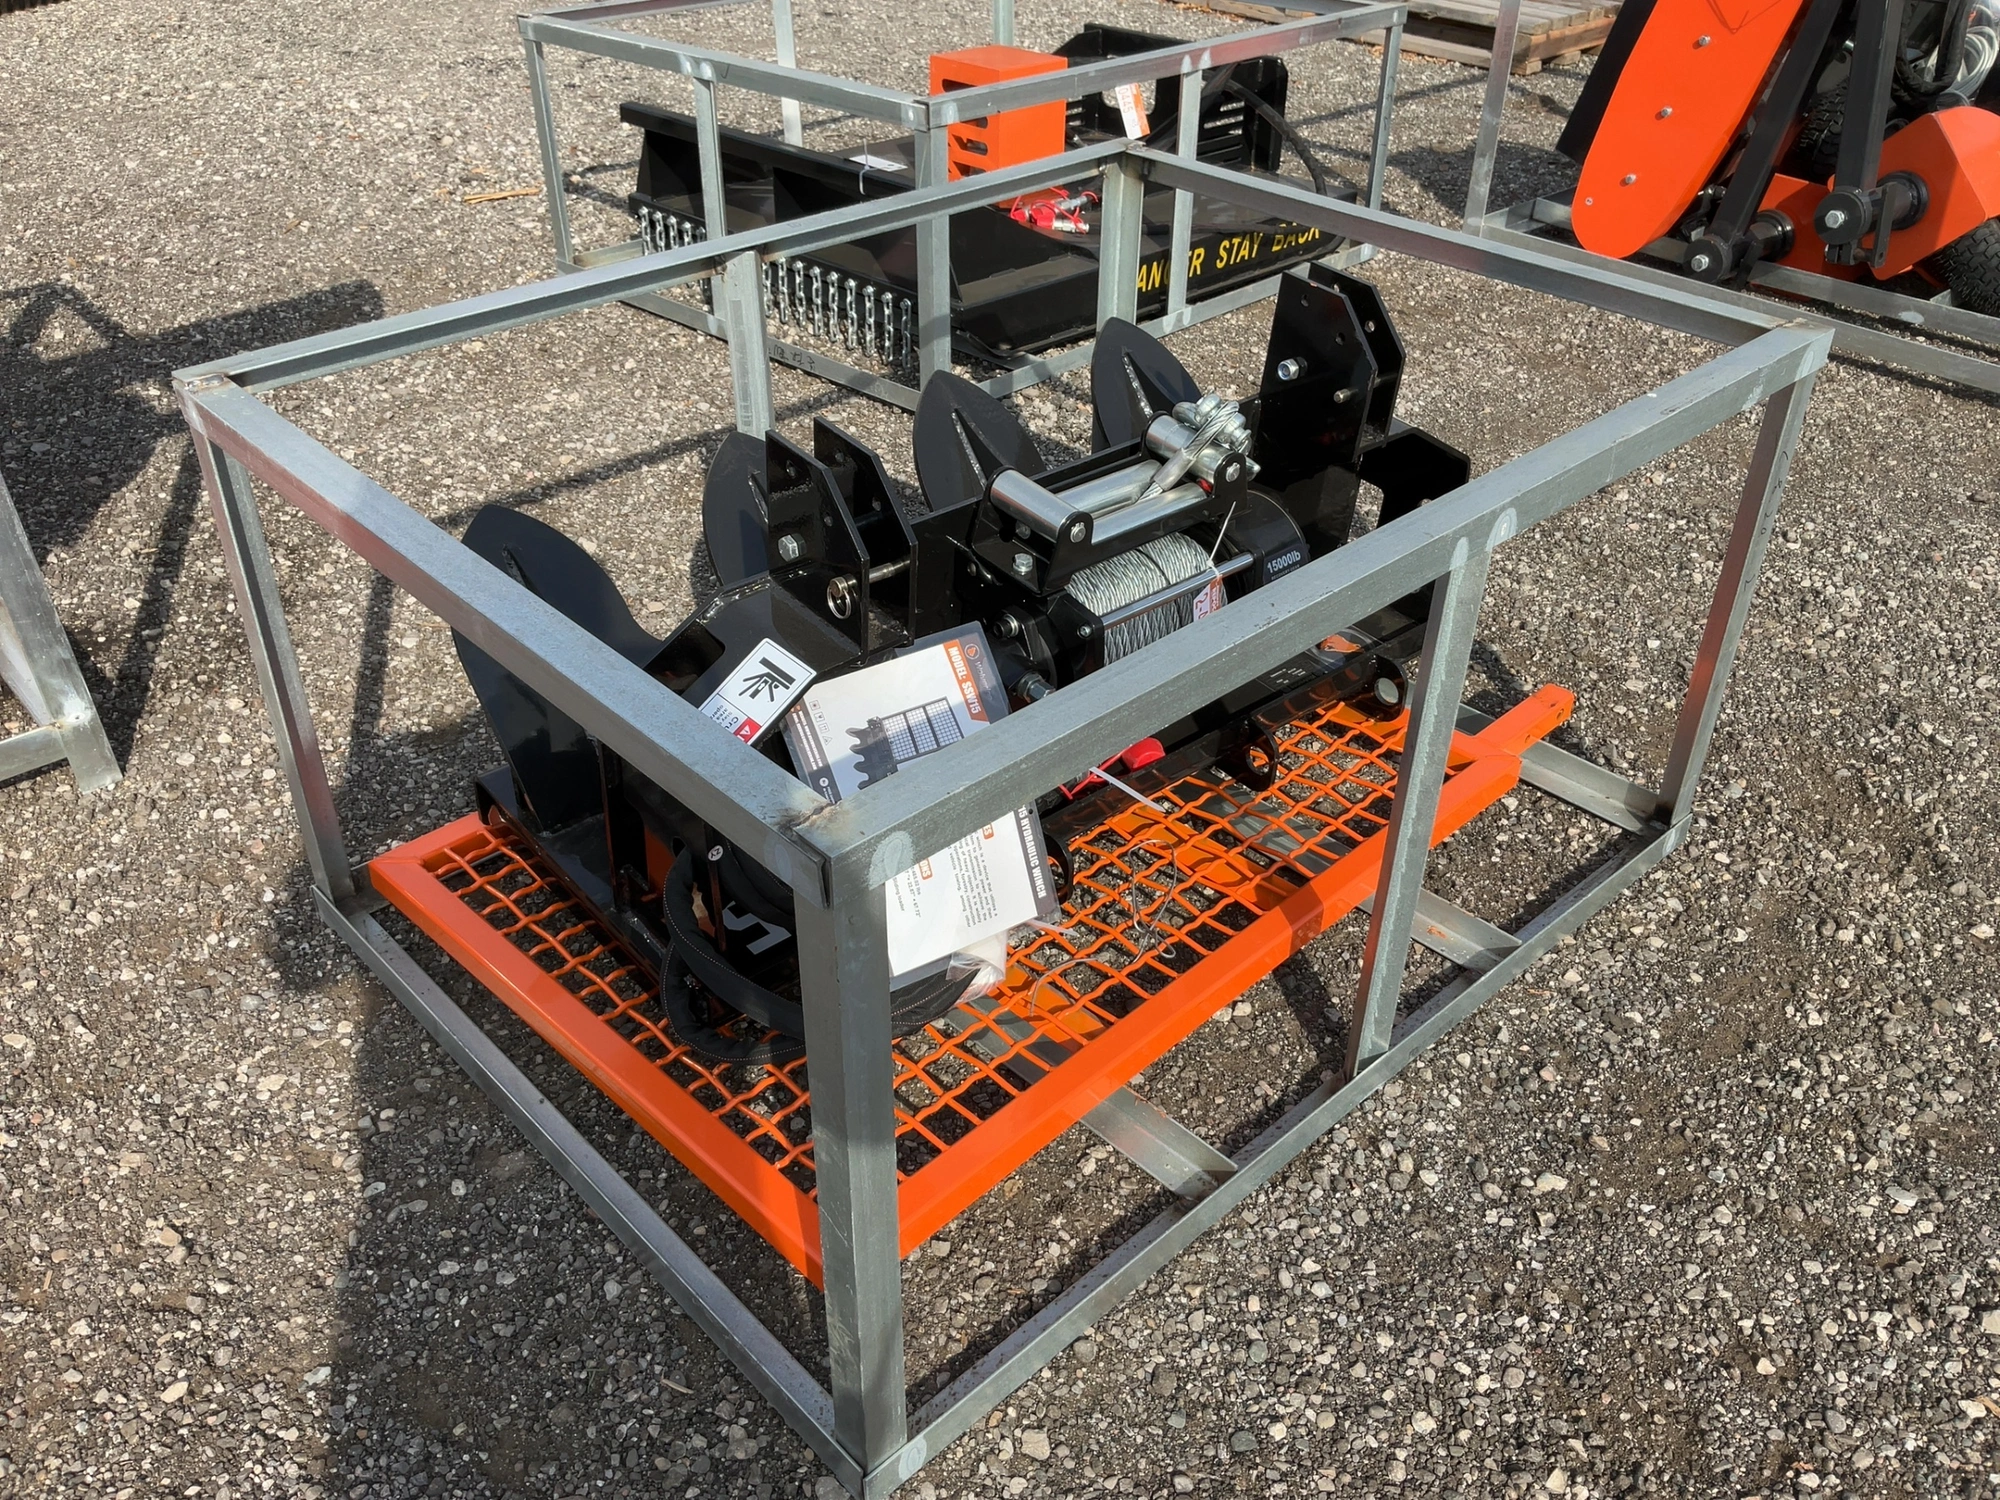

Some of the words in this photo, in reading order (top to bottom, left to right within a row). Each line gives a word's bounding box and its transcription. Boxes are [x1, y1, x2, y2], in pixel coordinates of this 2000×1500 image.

[1216, 232, 1263, 269] STAY
[1267, 551, 1301, 573] 15000lb
[947, 646, 968, 680] MODEL:
[961, 680, 981, 714] SSW15
[708, 847, 722, 859] ZY
[1020, 818, 1039, 867] HYDRAULIC
[1031, 867, 1046, 898] WINCH
